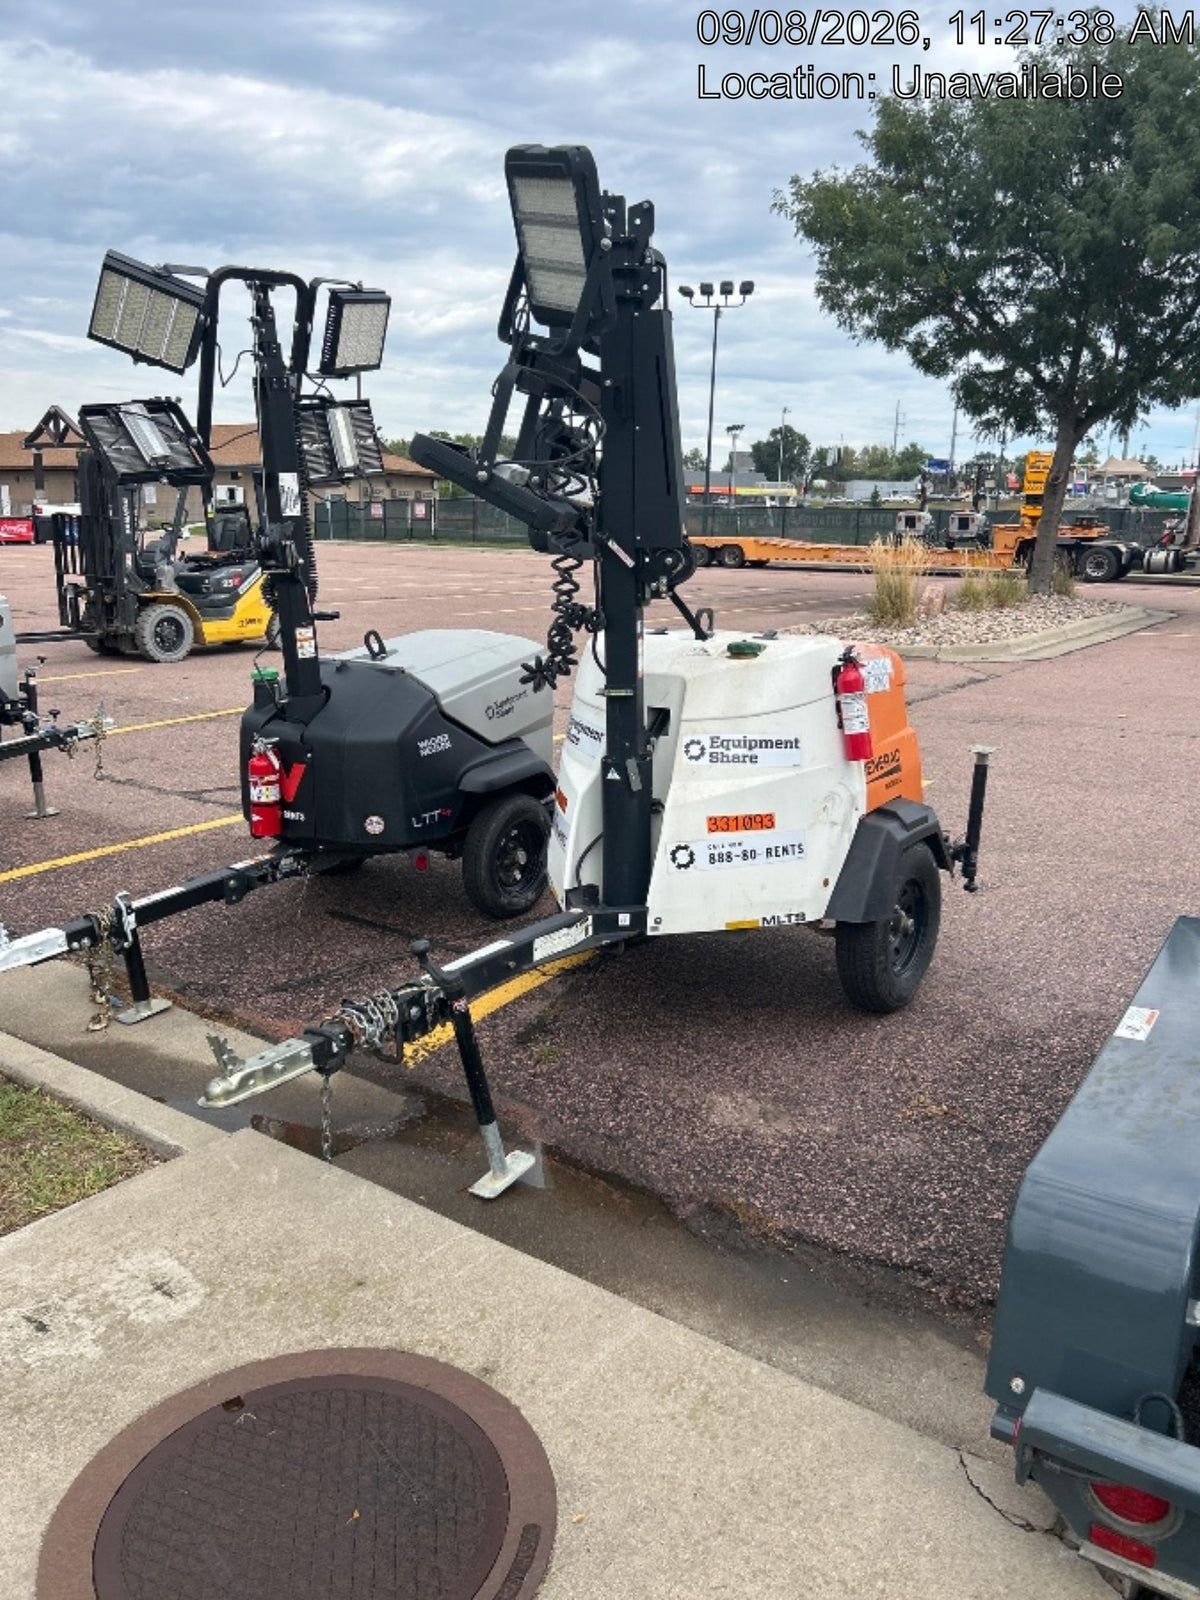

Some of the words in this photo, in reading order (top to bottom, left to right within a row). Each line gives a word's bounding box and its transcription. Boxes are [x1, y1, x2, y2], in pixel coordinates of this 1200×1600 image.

[709, 735, 800, 751] Equipment
[709, 752, 758, 763] Share
[707, 813, 774, 832] 331093
